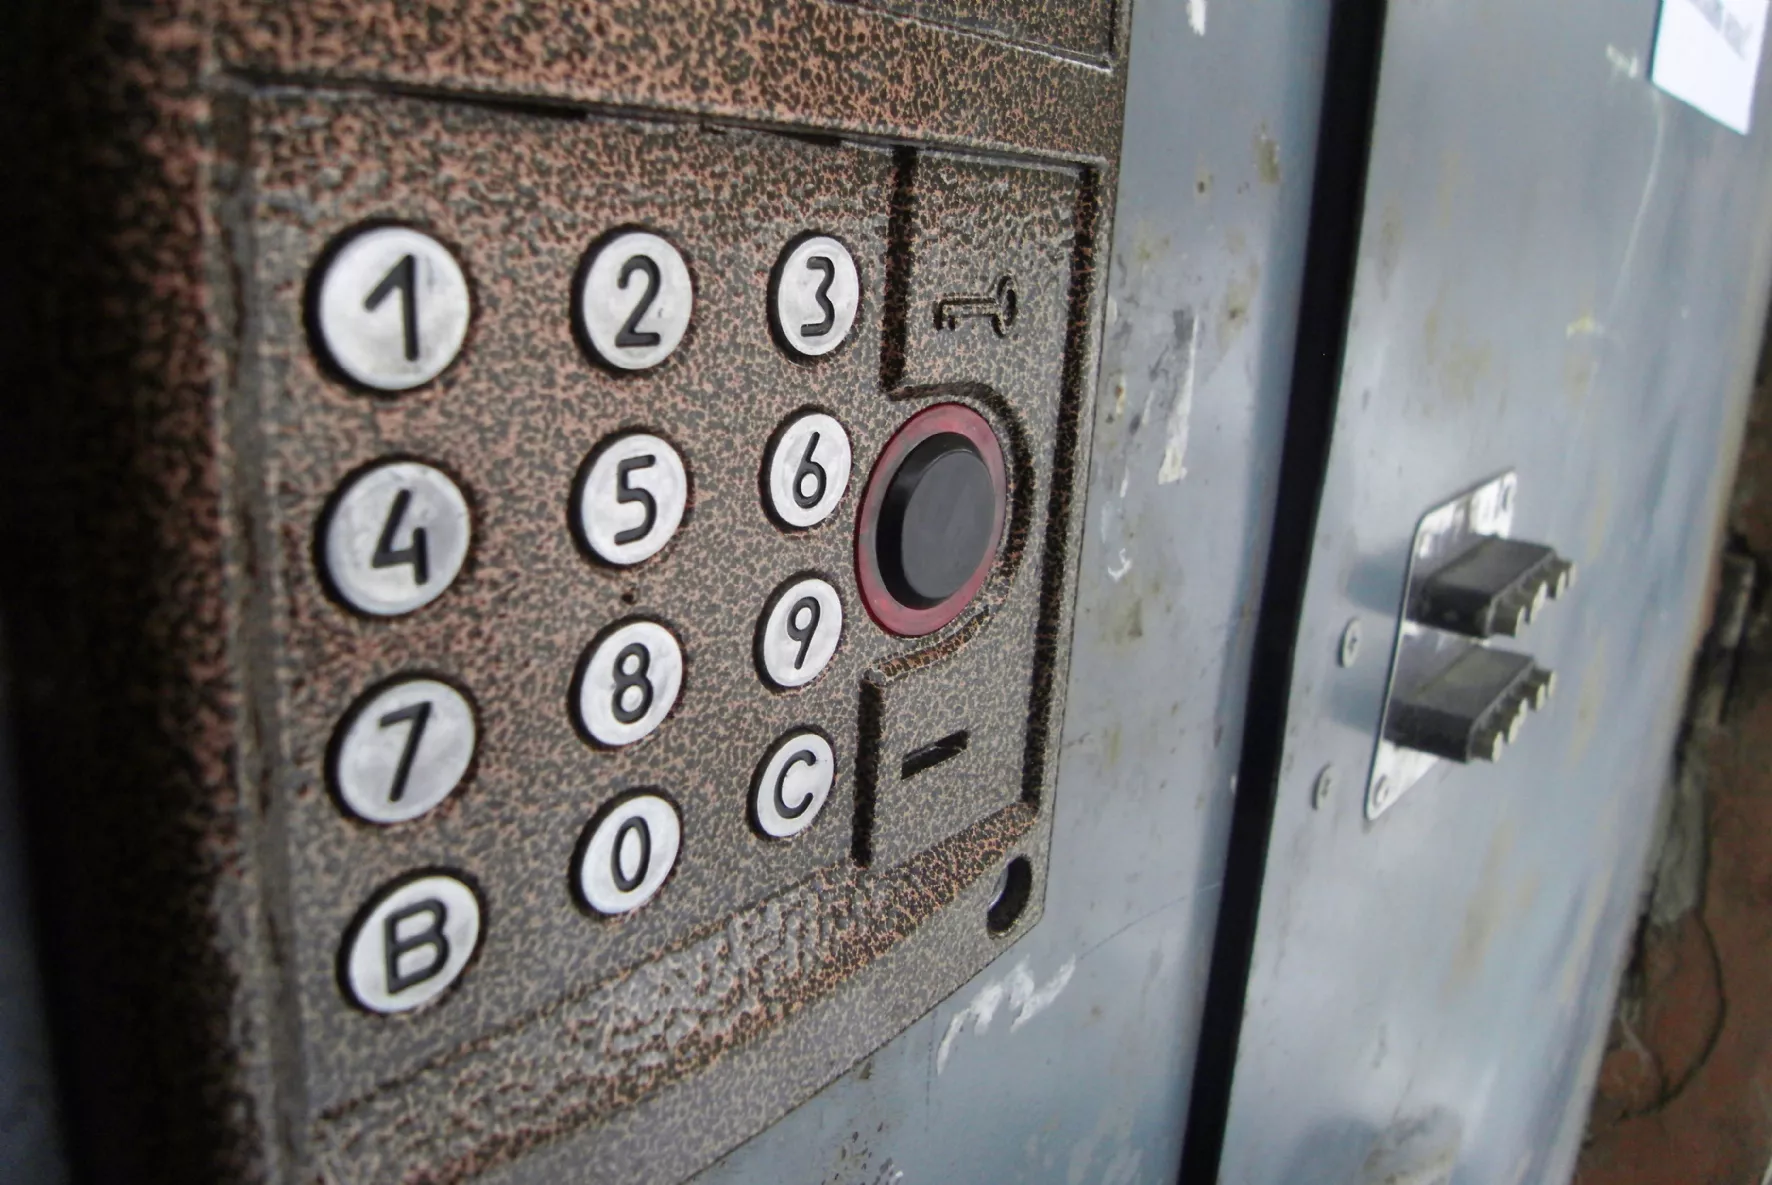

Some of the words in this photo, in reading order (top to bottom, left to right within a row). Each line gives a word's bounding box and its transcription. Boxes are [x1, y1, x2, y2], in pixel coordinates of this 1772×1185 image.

[363, 252, 420, 363] 1
[614, 253, 662, 349] 2
[799, 254, 837, 338] 3
[612, 453, 658, 547] 5
[791, 430, 829, 510] 6
[370, 487, 430, 586] 4
[785, 595, 822, 671] 9
[610, 641, 655, 725] 8
[378, 699, 433, 803] 7
[773, 748, 818, 820] C
[382, 897, 451, 996] B
